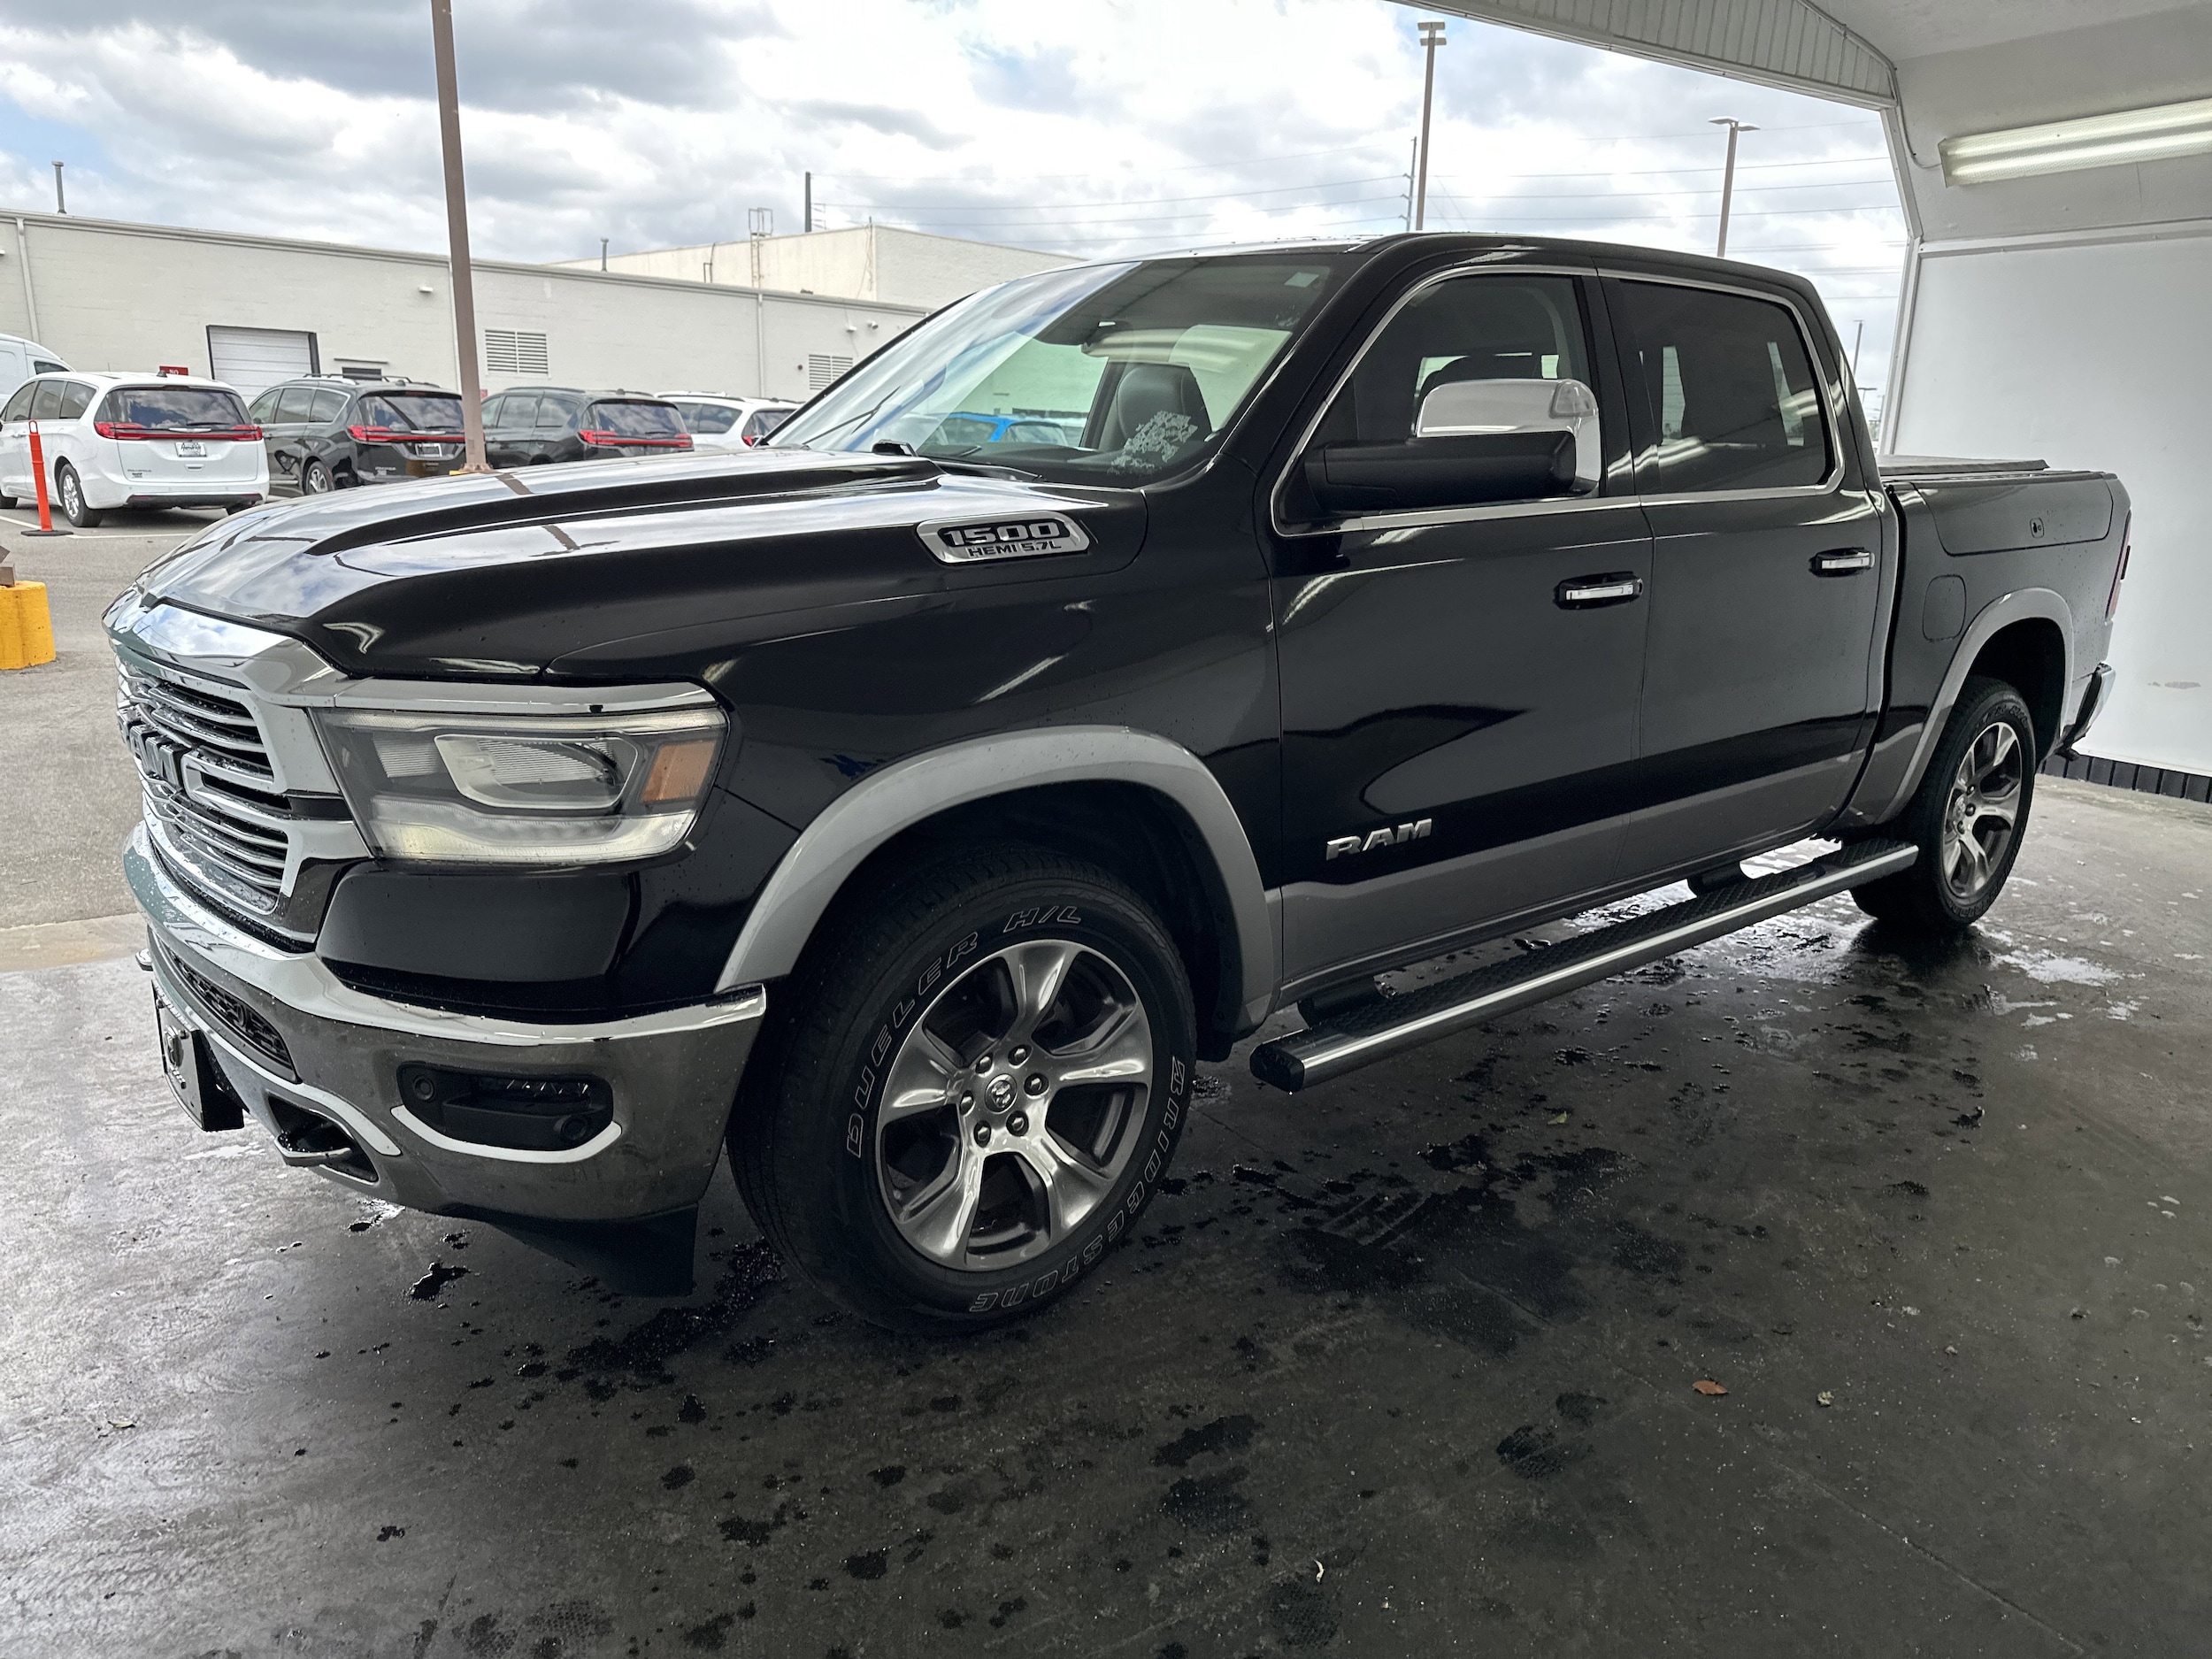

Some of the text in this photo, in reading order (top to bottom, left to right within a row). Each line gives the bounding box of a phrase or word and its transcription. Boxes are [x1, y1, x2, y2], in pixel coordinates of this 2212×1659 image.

[943, 521, 1061, 546] 1500
[967, 539, 1063, 557] HEMI 5.7L
[1325, 818, 1432, 861] RAM
[846, 904, 1083, 1159] DUELER H/L
[968, 1056, 1187, 1313] BRIDGESTONE
